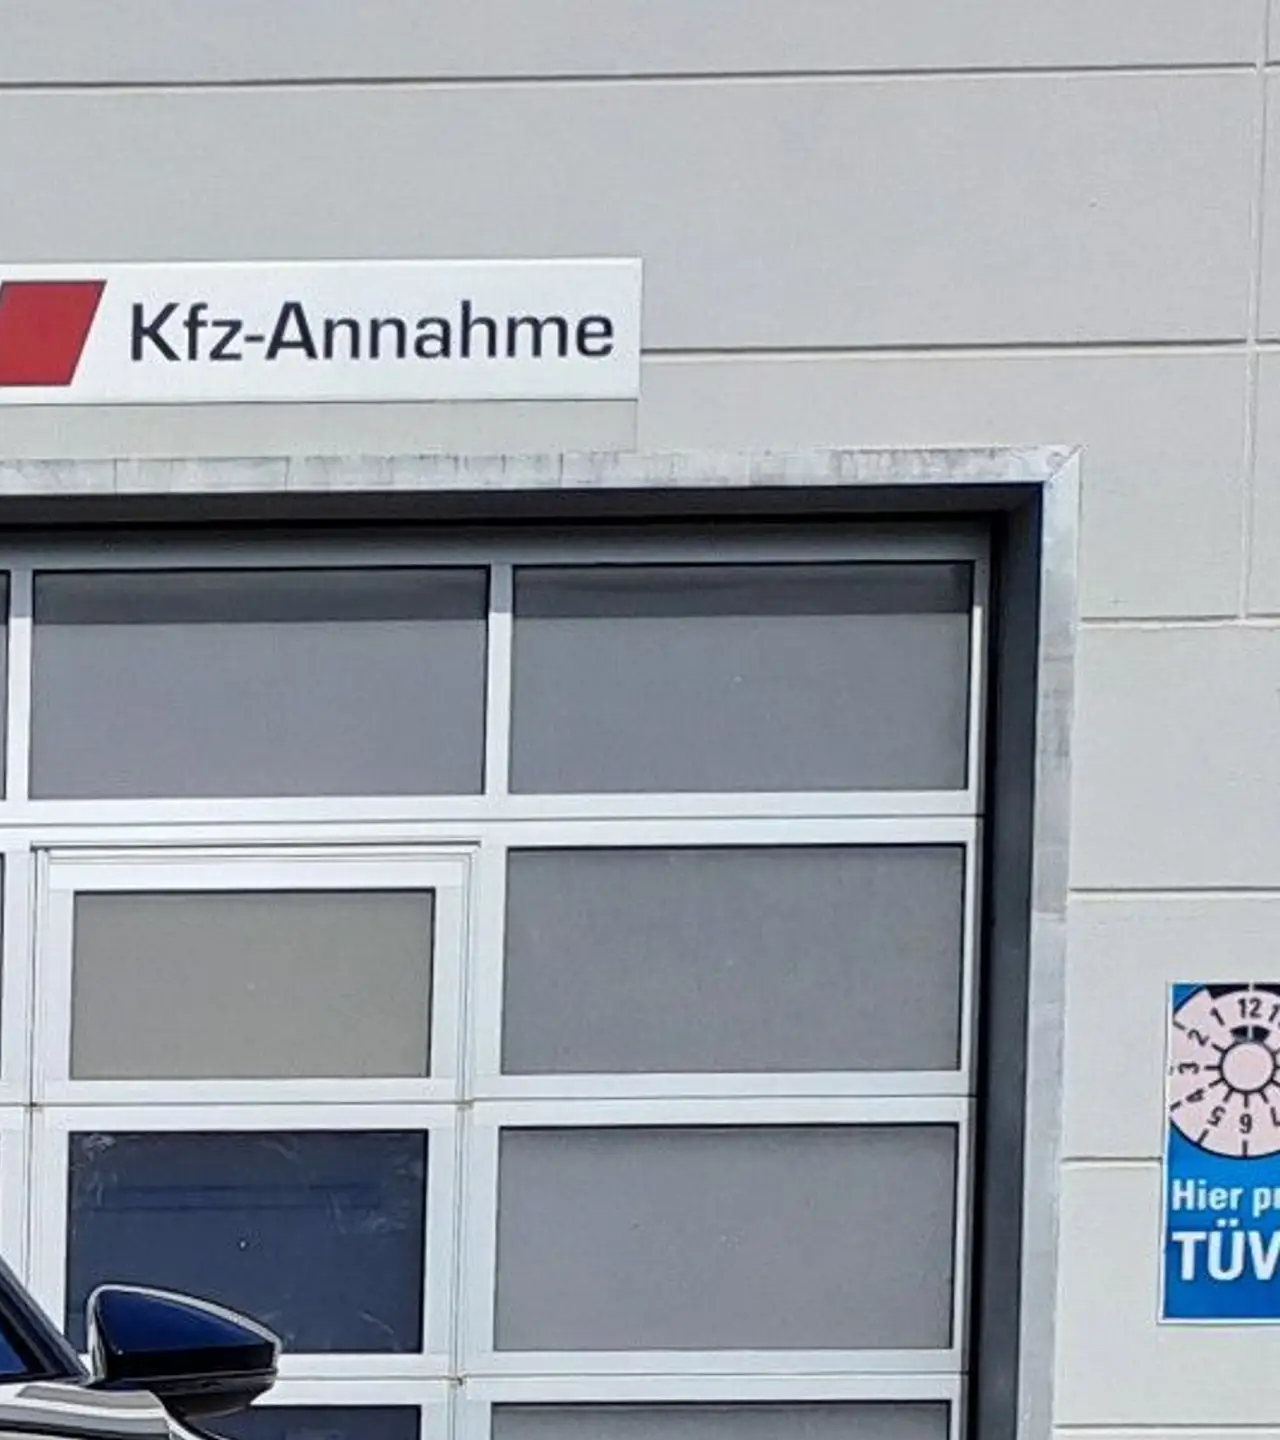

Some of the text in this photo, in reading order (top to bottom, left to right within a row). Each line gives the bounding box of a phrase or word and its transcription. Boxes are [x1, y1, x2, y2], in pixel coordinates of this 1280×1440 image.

[131, 299, 614, 361] Kfz-Annahme
[1210, 1007, 1225, 1026] 1
[1238, 998, 1262, 1018] 12
[1187, 1029, 1209, 1047] 2
[1178, 1062, 1200, 1075] 3
[1186, 1088, 1205, 1103] 4
[1207, 1106, 1226, 1127] 5
[1171, 1178, 1244, 1211] Hier
[1171, 1218, 1280, 1281] TÜV
